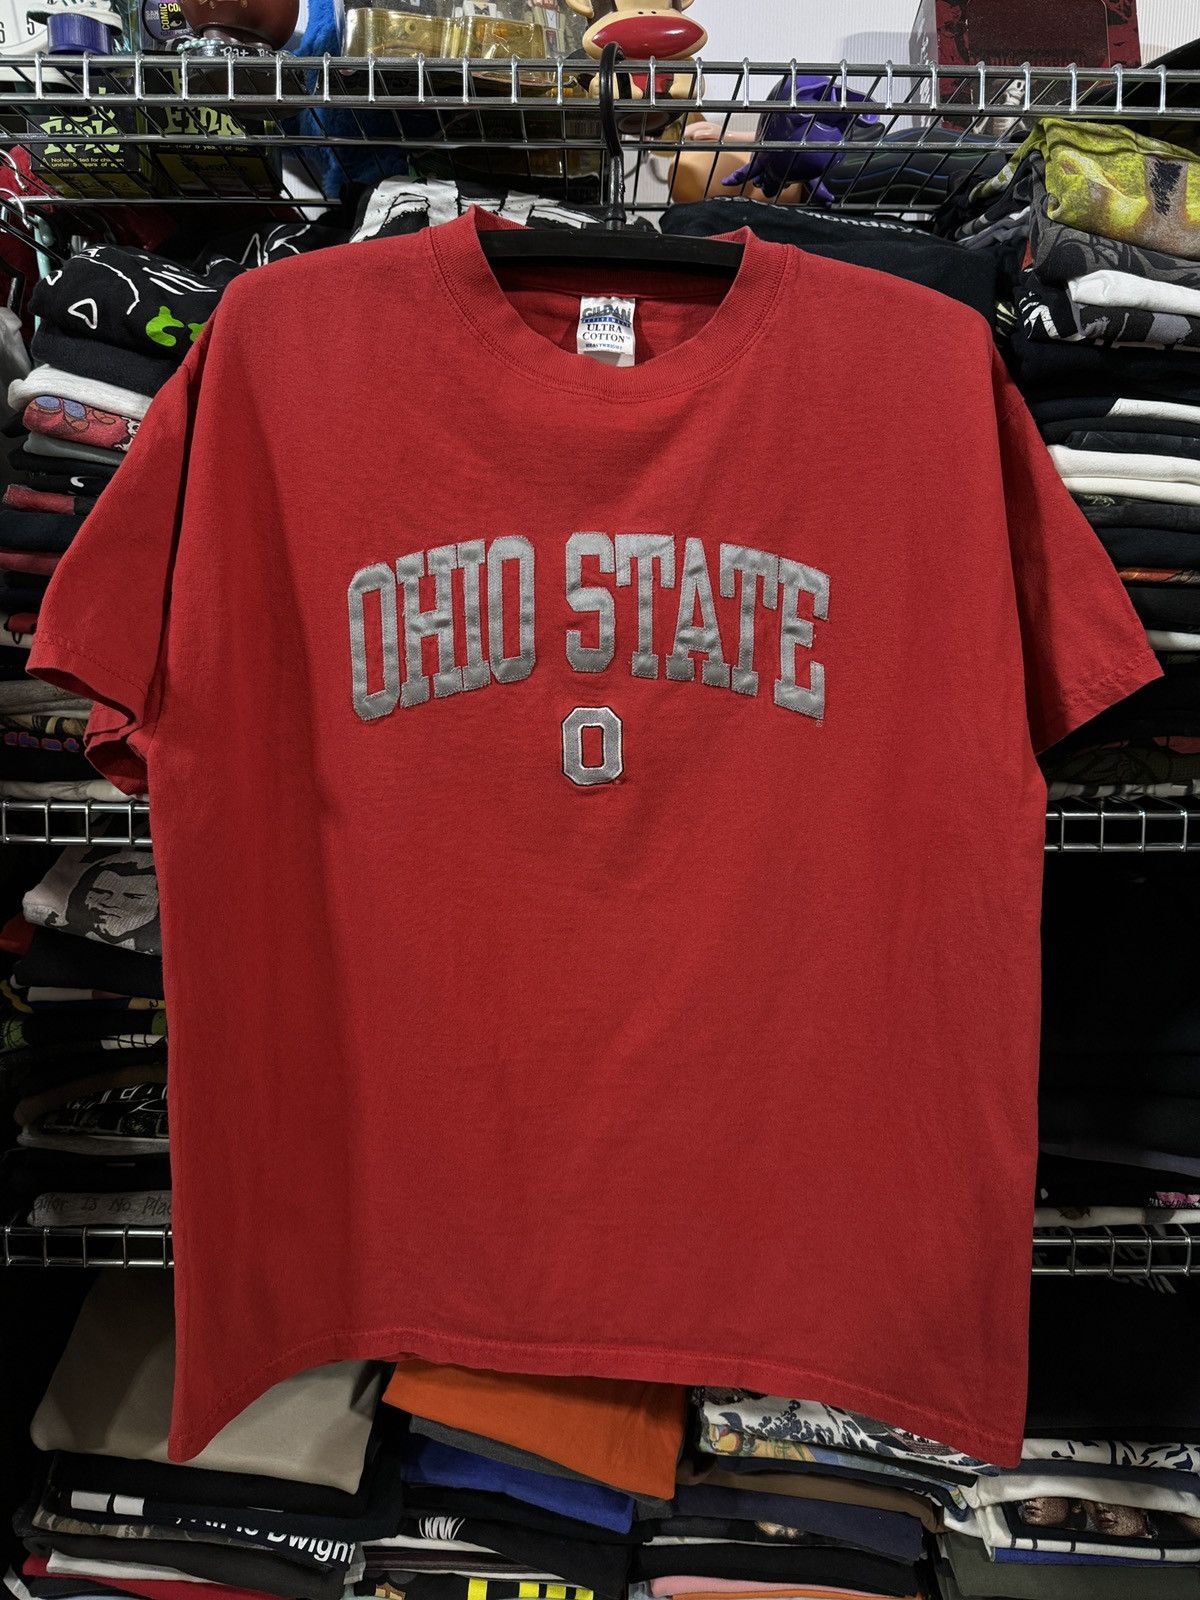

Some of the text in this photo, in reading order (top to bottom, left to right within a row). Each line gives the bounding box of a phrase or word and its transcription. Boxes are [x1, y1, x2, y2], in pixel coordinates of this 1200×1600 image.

[159, 3, 170, 31] COMIC
[582, 331, 625, 344] COTTON
[587, 323, 622, 334] ULTRA
[347, 531, 831, 722] OHIO STATE
[561, 705, 625, 786] O
